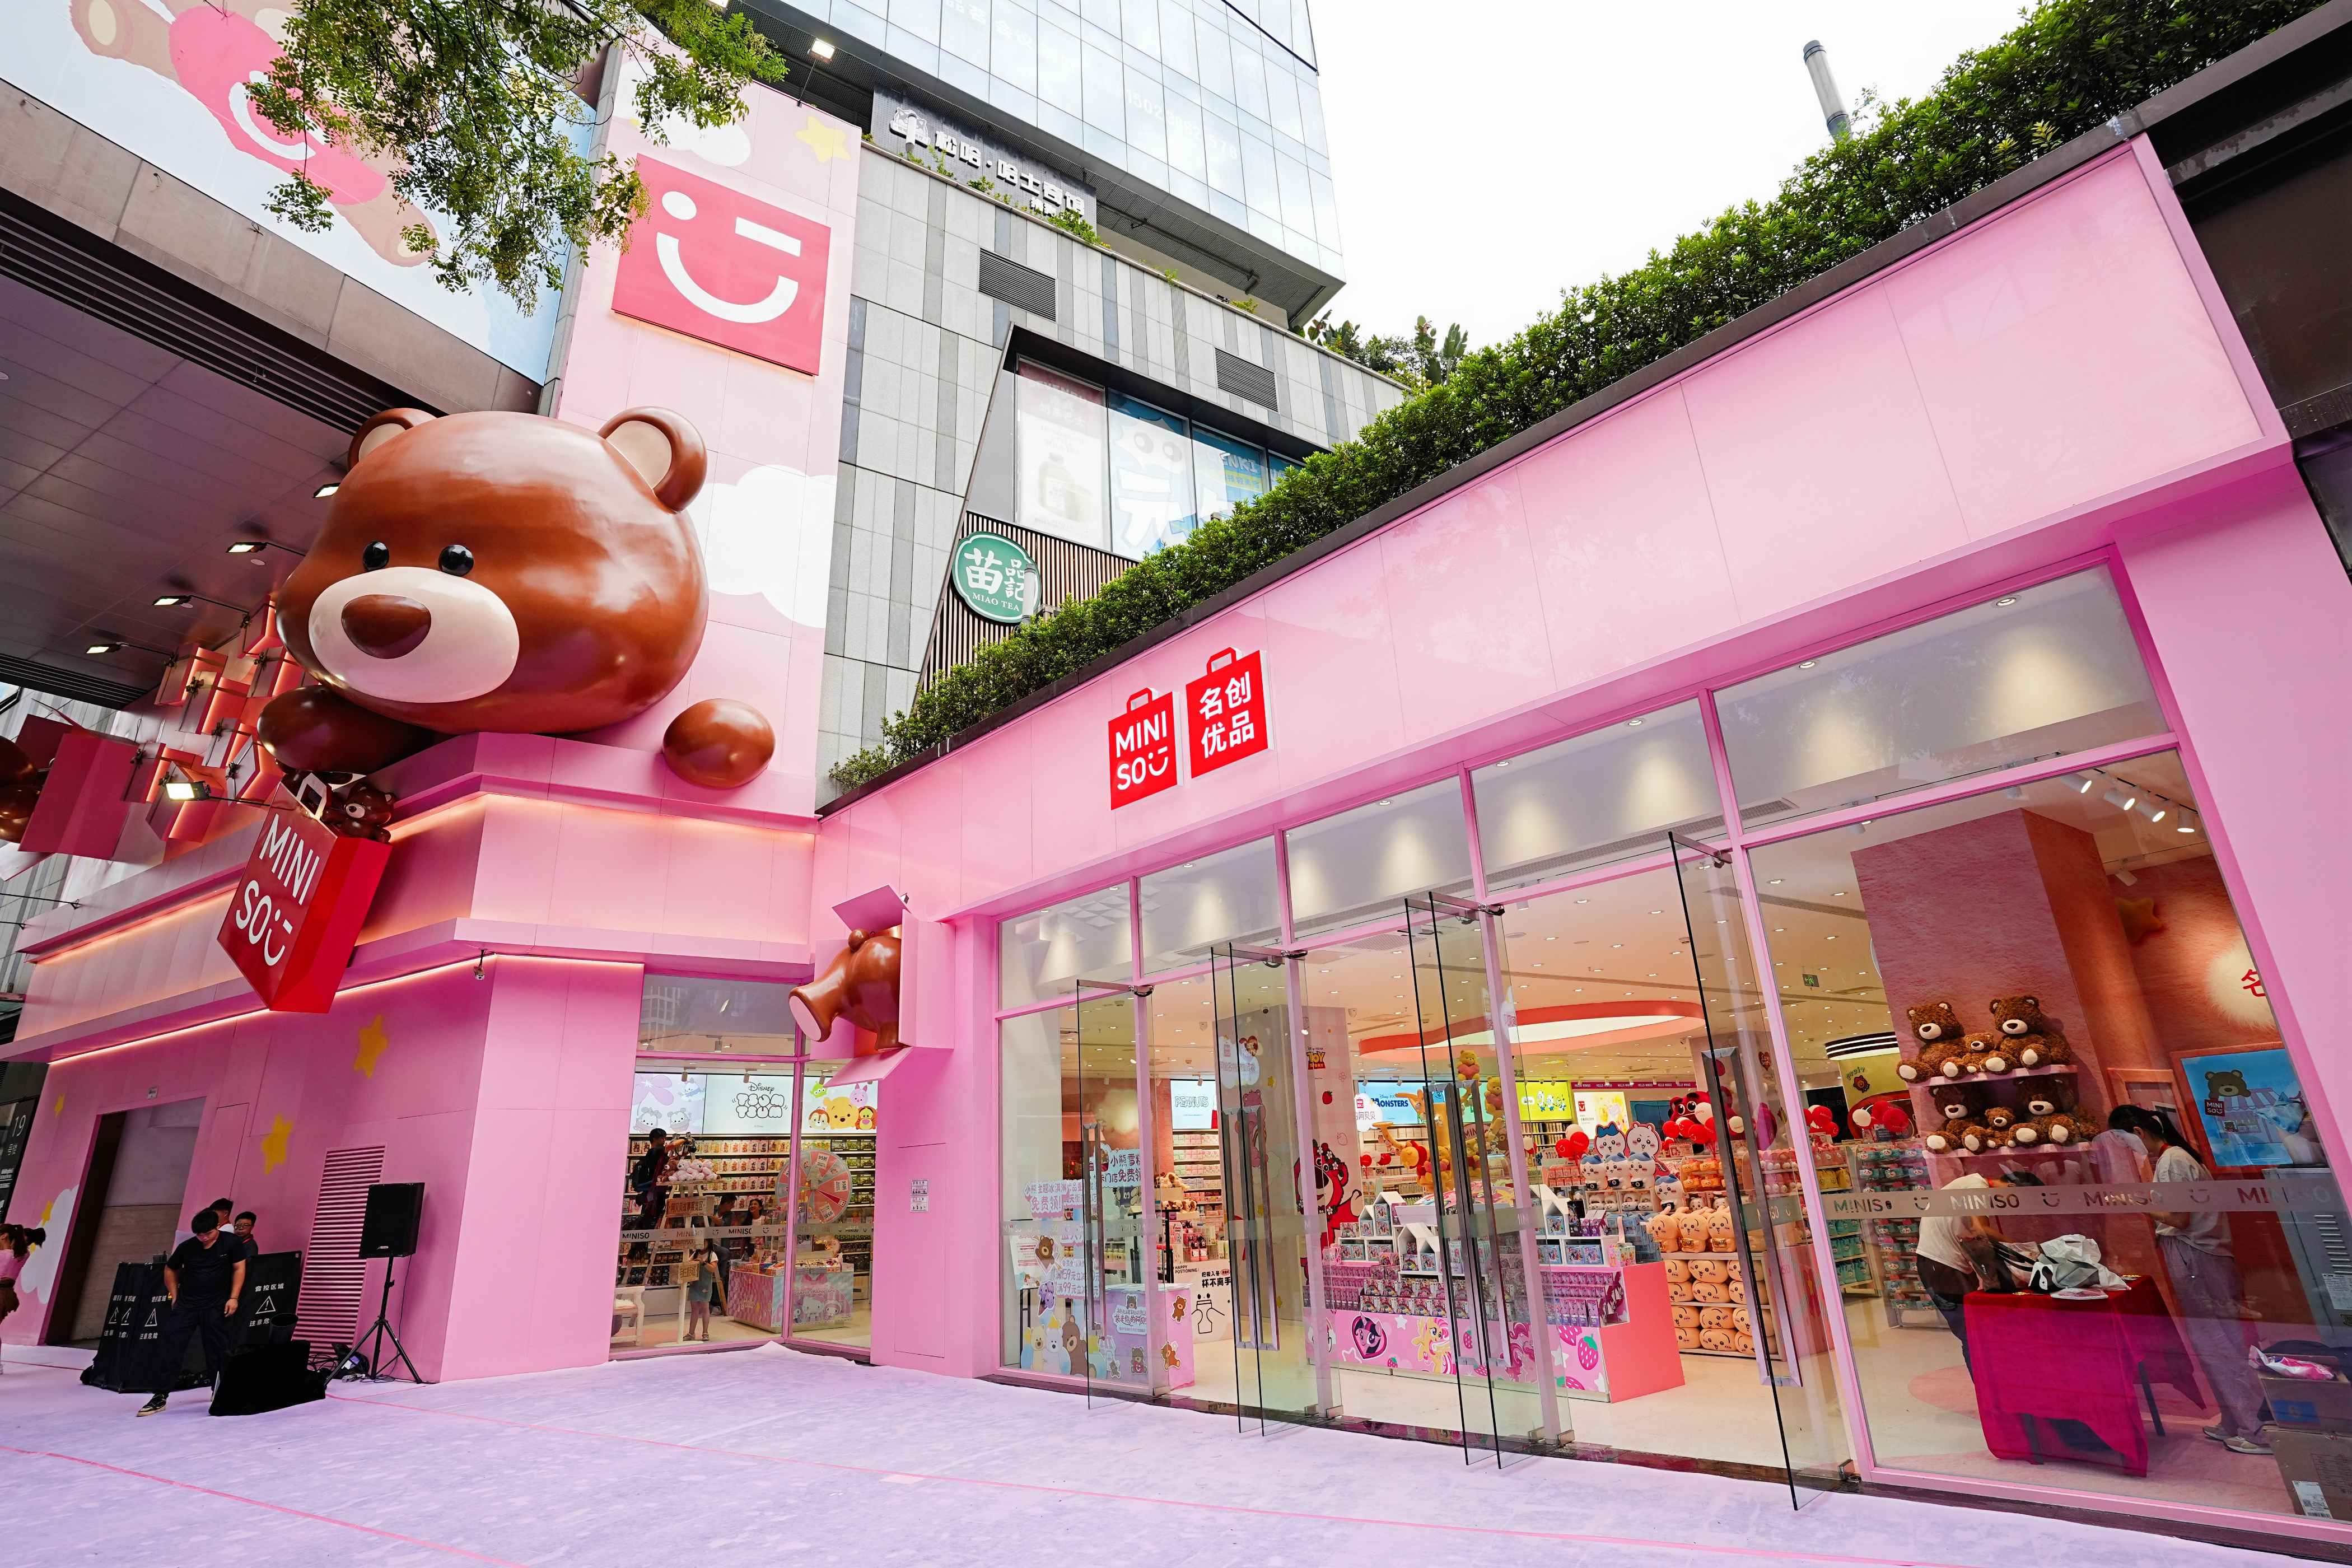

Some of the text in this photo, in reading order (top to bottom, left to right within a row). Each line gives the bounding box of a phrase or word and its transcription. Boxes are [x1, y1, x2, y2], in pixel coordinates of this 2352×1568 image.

[973, 592, 1020, 612] MIAO TEA
[1199, 671, 1251, 720] 名创
[1116, 711, 1167, 758] MINI
[1201, 710, 1255, 759] 优品
[259, 813, 320, 906] MINI
[1175, 1096, 1208, 1107] PEANUTS
[12, 1114, 26, 1137] 19
[1949, 1193, 2020, 1210] MINISO
[2083, 1189, 2163, 1206] MINISO
[255, 1283, 284, 1292] 音控区域
